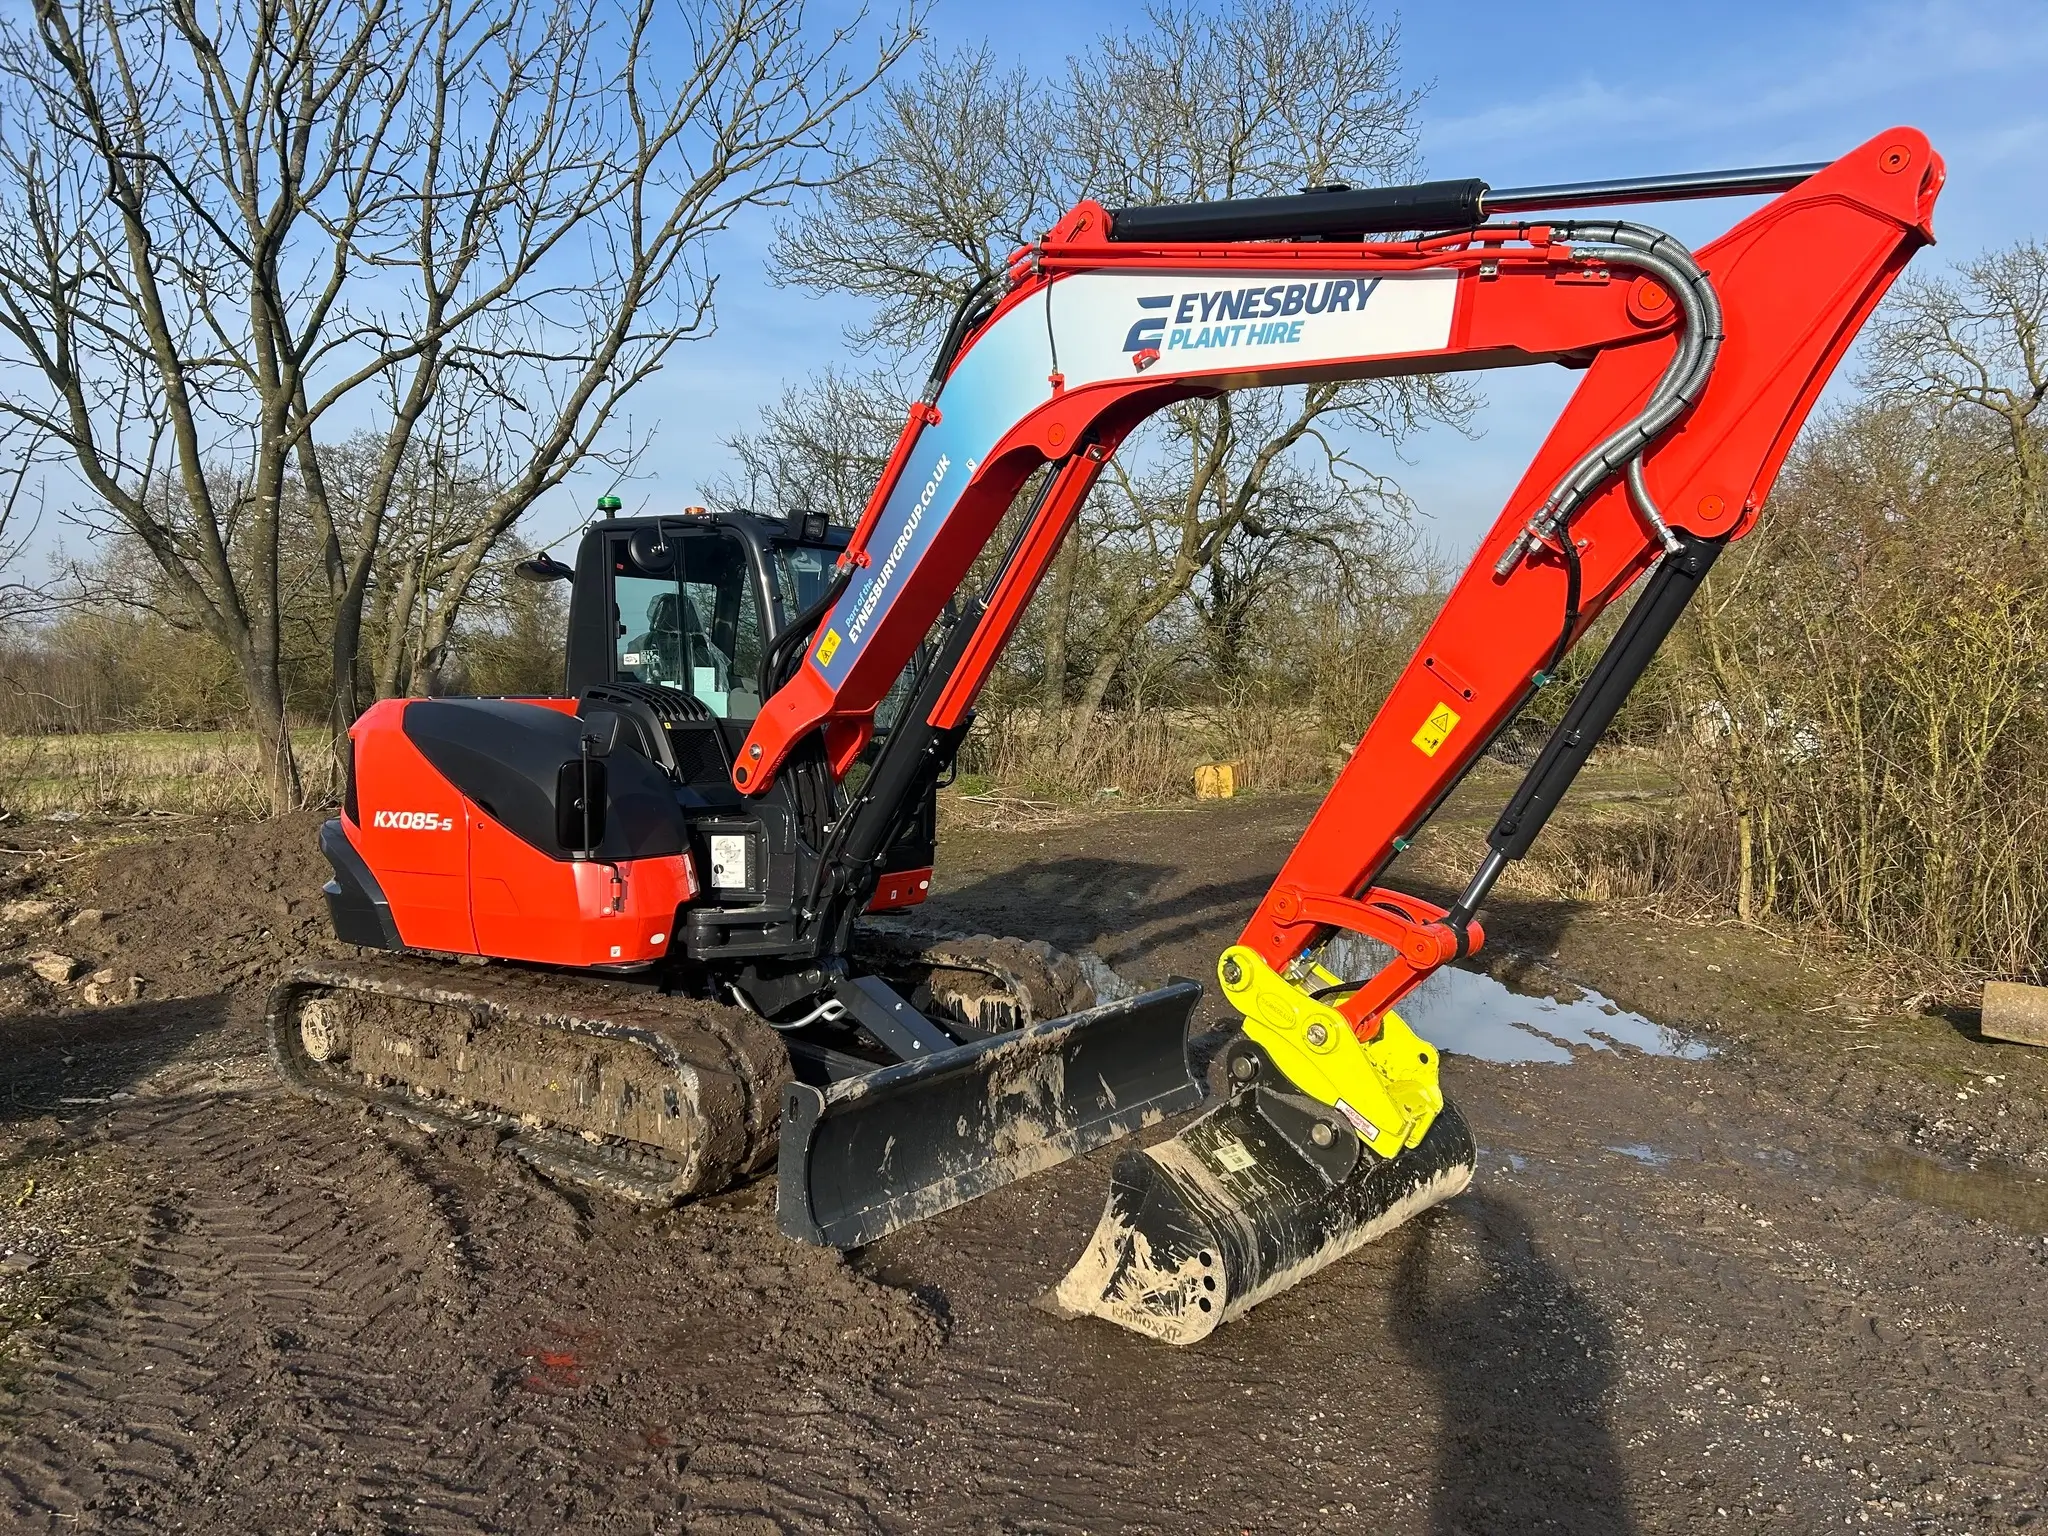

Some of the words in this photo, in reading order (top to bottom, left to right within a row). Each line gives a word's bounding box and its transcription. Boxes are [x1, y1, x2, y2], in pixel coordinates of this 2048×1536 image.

[1174, 276, 1384, 325] EYNESBURY
[1168, 324, 1247, 351] PLANT
[1245, 320, 1305, 346] HIRE
[848, 453, 951, 645] EYNESBURYGROUP.CO.UK
[857, 591, 866, 607] of
[862, 577, 874, 596] the
